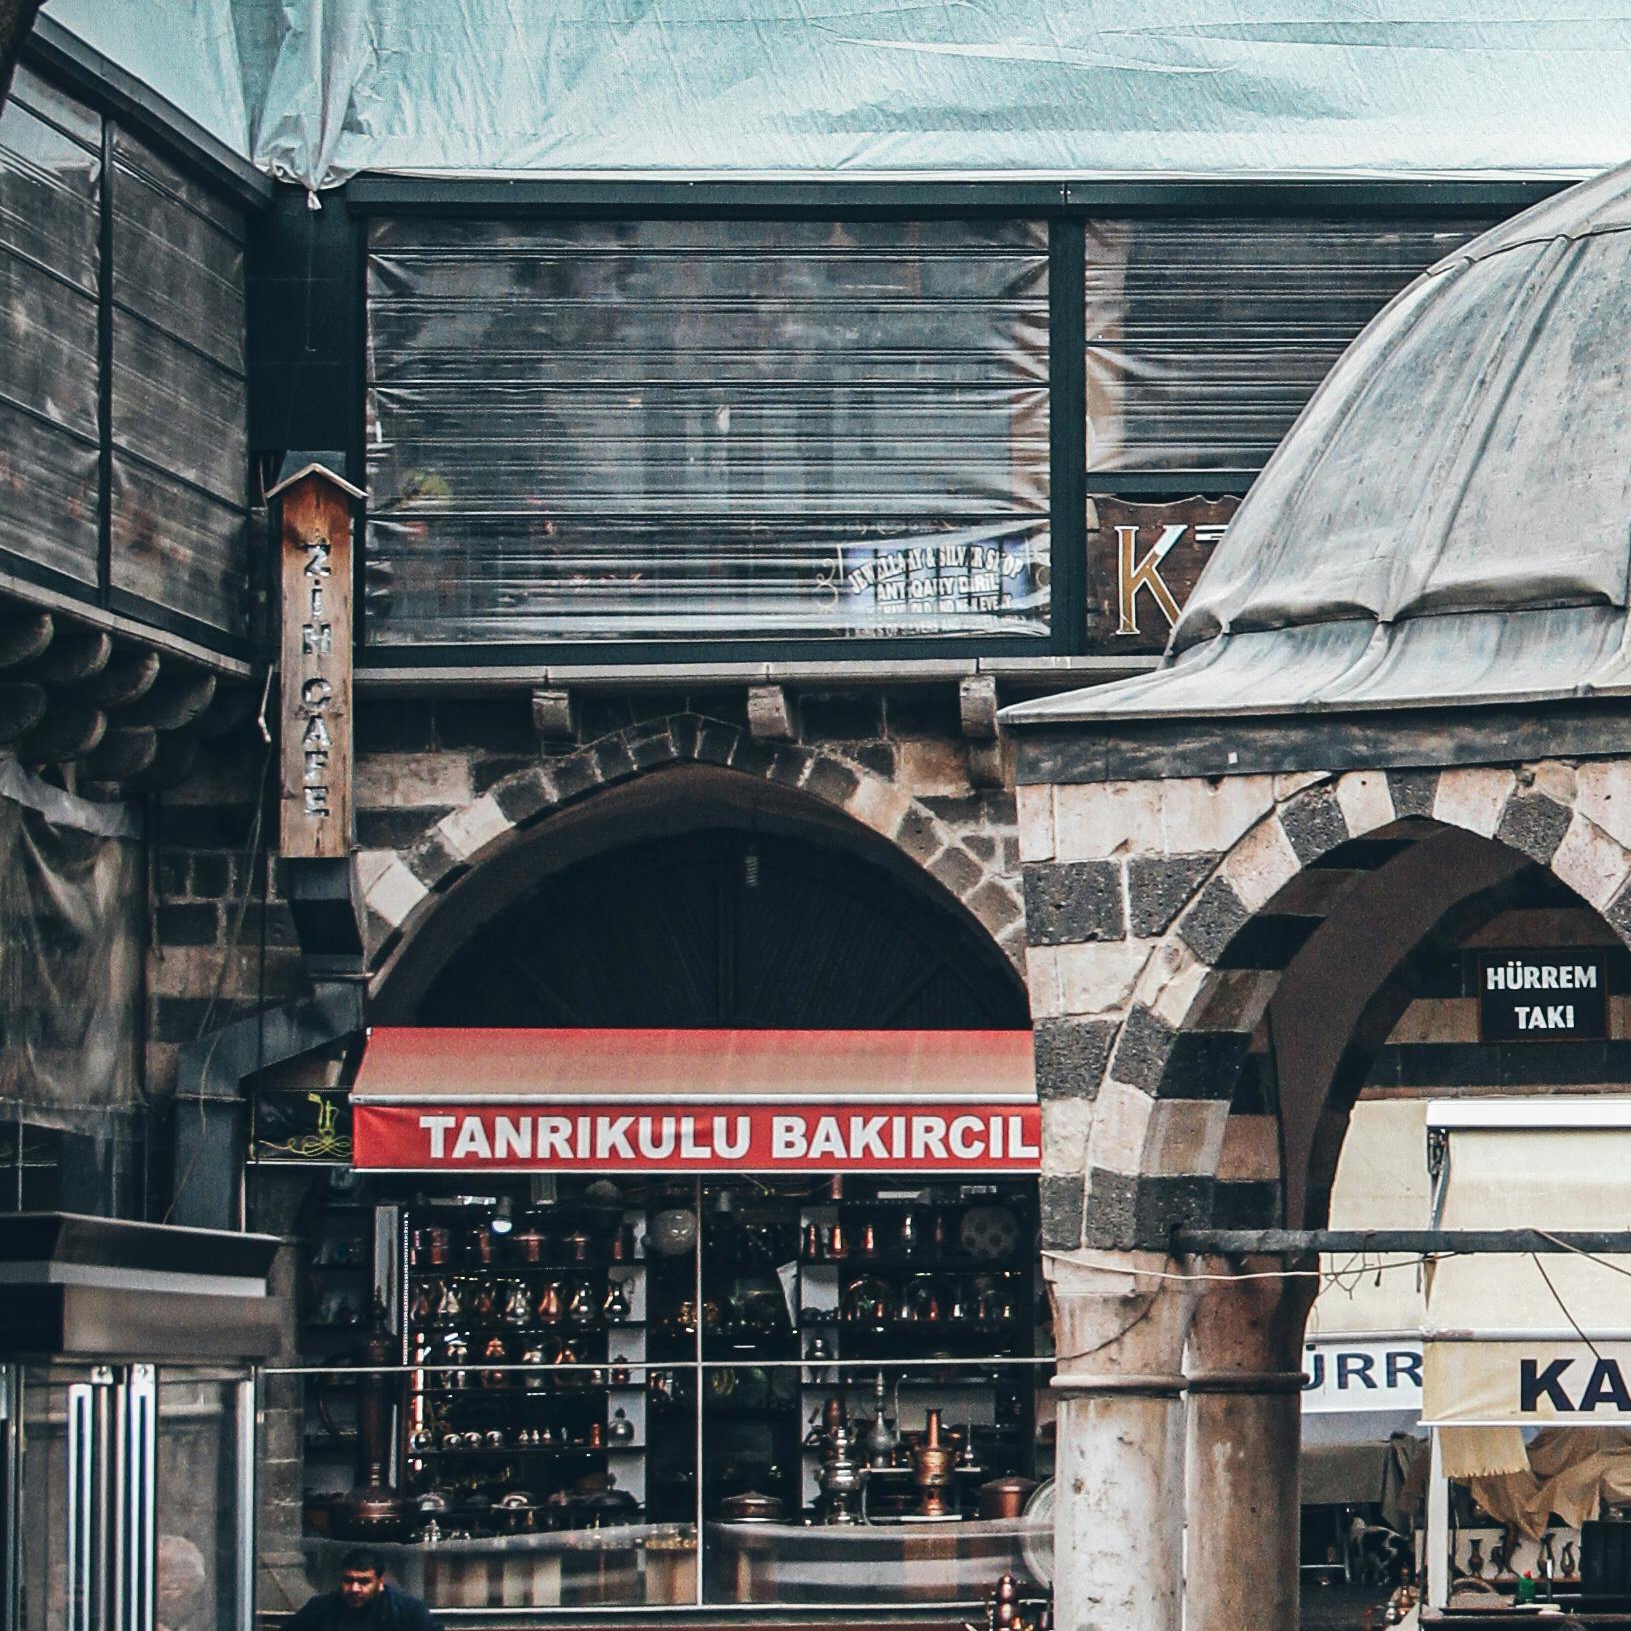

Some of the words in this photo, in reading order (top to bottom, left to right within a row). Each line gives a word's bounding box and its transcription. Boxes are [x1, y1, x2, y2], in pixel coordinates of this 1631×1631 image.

[301, 677, 332, 818] CAFE
[1486, 960, 1597, 990] HÜRREM
[1514, 1005, 1575, 1030] TAKI
[420, 1114, 751, 1160] TANRIKULU
[772, 1114, 1040, 1160] BAKIRCIL
